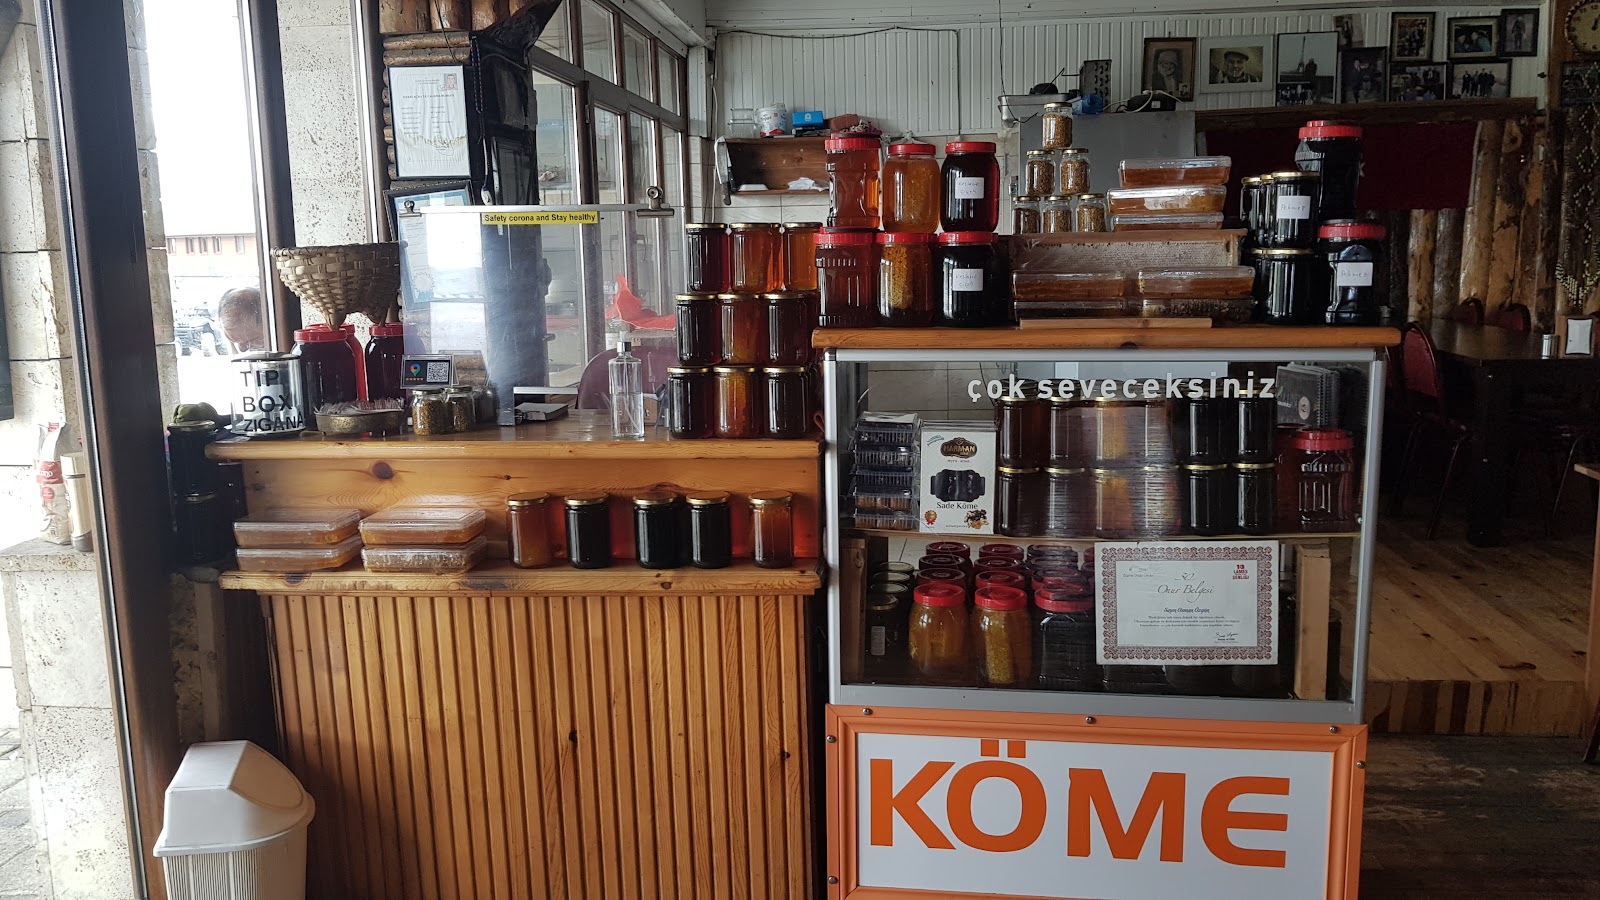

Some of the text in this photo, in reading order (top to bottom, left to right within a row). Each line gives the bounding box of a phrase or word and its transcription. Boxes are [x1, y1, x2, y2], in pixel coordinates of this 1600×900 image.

[484, 214, 507, 222] Safety
[551, 214, 568, 222] Stay
[568, 213, 596, 222] healthy
[240, 369, 279, 387] TIP
[967, 370, 1276, 403] çok seveceksiniz
[242, 394, 293, 413] BOX
[243, 410, 304, 432] ZIGANA
[943, 445, 976, 453] HARMAN
[936, 501, 979, 510] Sade Köme
[1157, 580, 1215, 603] Onur Belgesi
[869, 738, 1291, 869] KÖME
